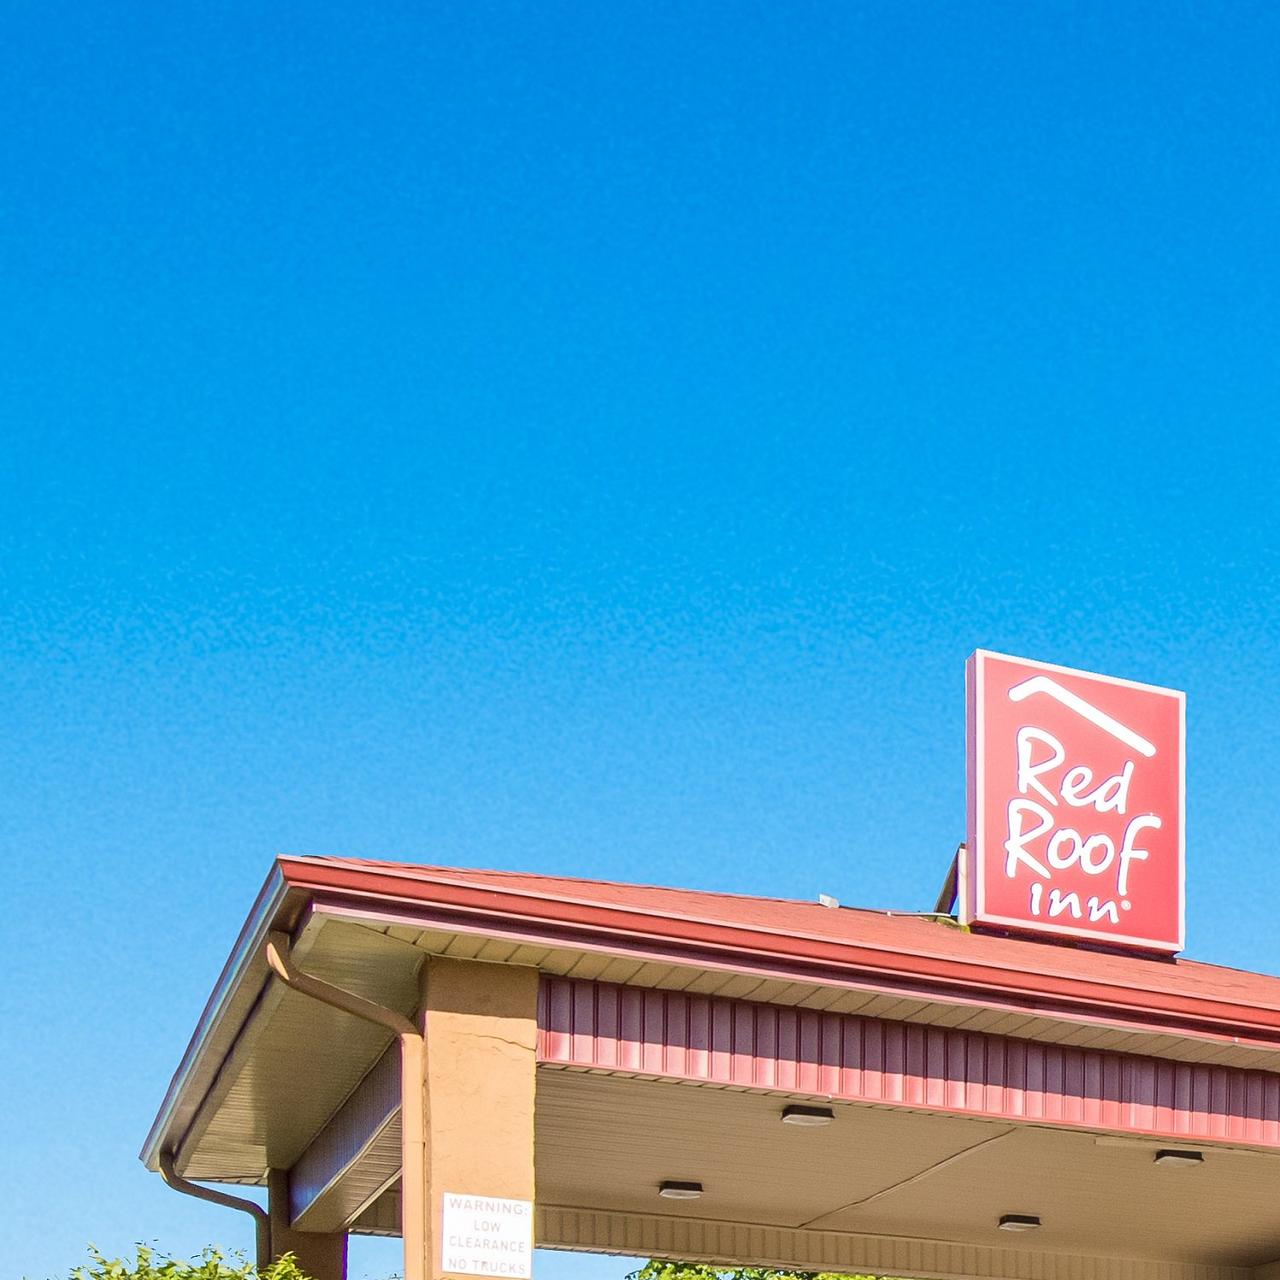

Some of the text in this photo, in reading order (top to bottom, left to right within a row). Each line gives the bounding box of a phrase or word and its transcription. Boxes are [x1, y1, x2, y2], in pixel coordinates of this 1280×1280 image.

[1017, 726, 1134, 814] Red
[1004, 798, 1162, 896] Roof
[449, 1198, 528, 1216] WARNING:
[473, 1220, 502, 1233] LOW
[449, 1235, 525, 1253] CLEARANCE
[448, 1258, 526, 1274] NO TRUCKS
